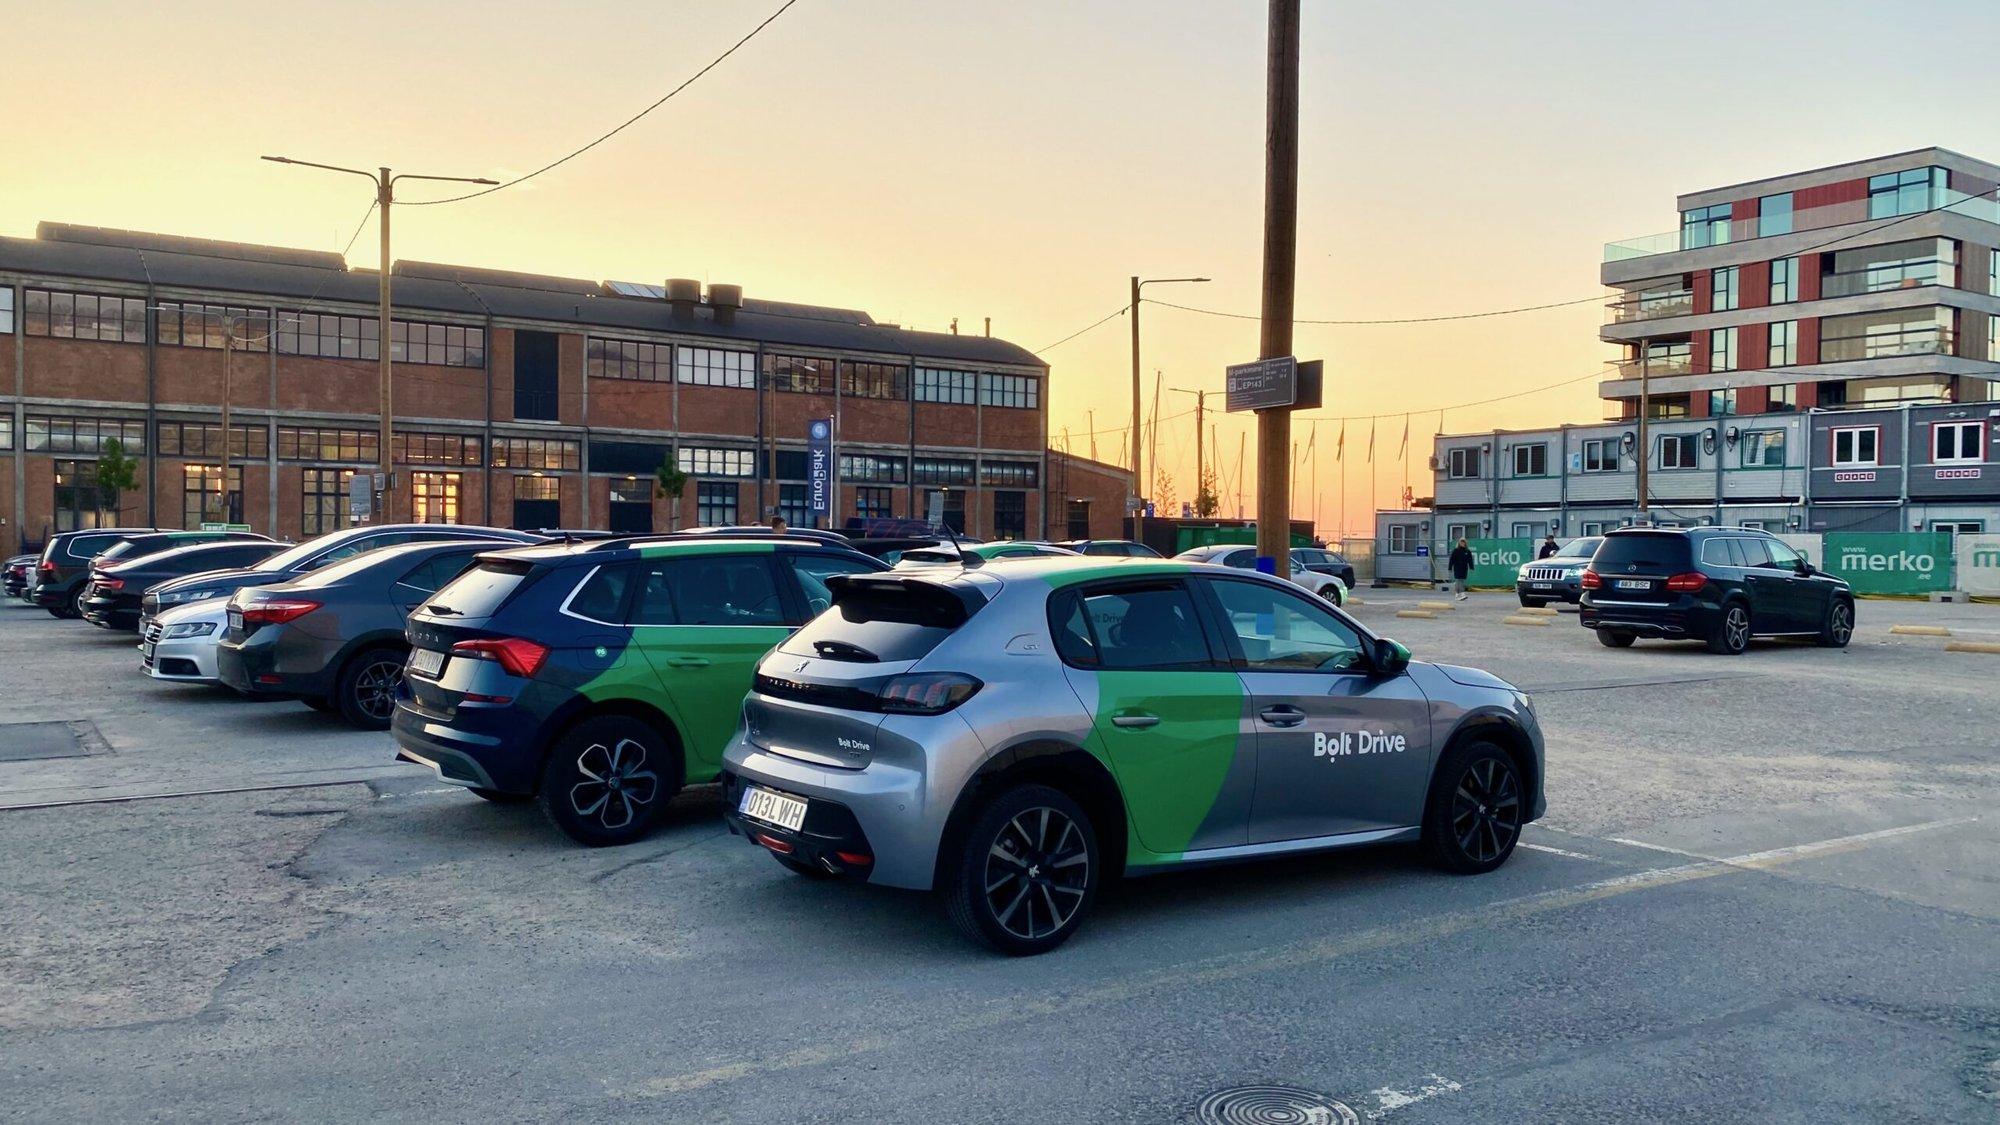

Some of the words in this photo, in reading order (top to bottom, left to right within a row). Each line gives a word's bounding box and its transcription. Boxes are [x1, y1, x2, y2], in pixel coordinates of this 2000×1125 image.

[1841, 551, 1934, 571] merko
[838, 737, 851, 749] Bolt
[852, 740, 870, 751] Drive
[1314, 732, 1351, 763] Bolt
[1358, 729, 1405, 754] Drive
